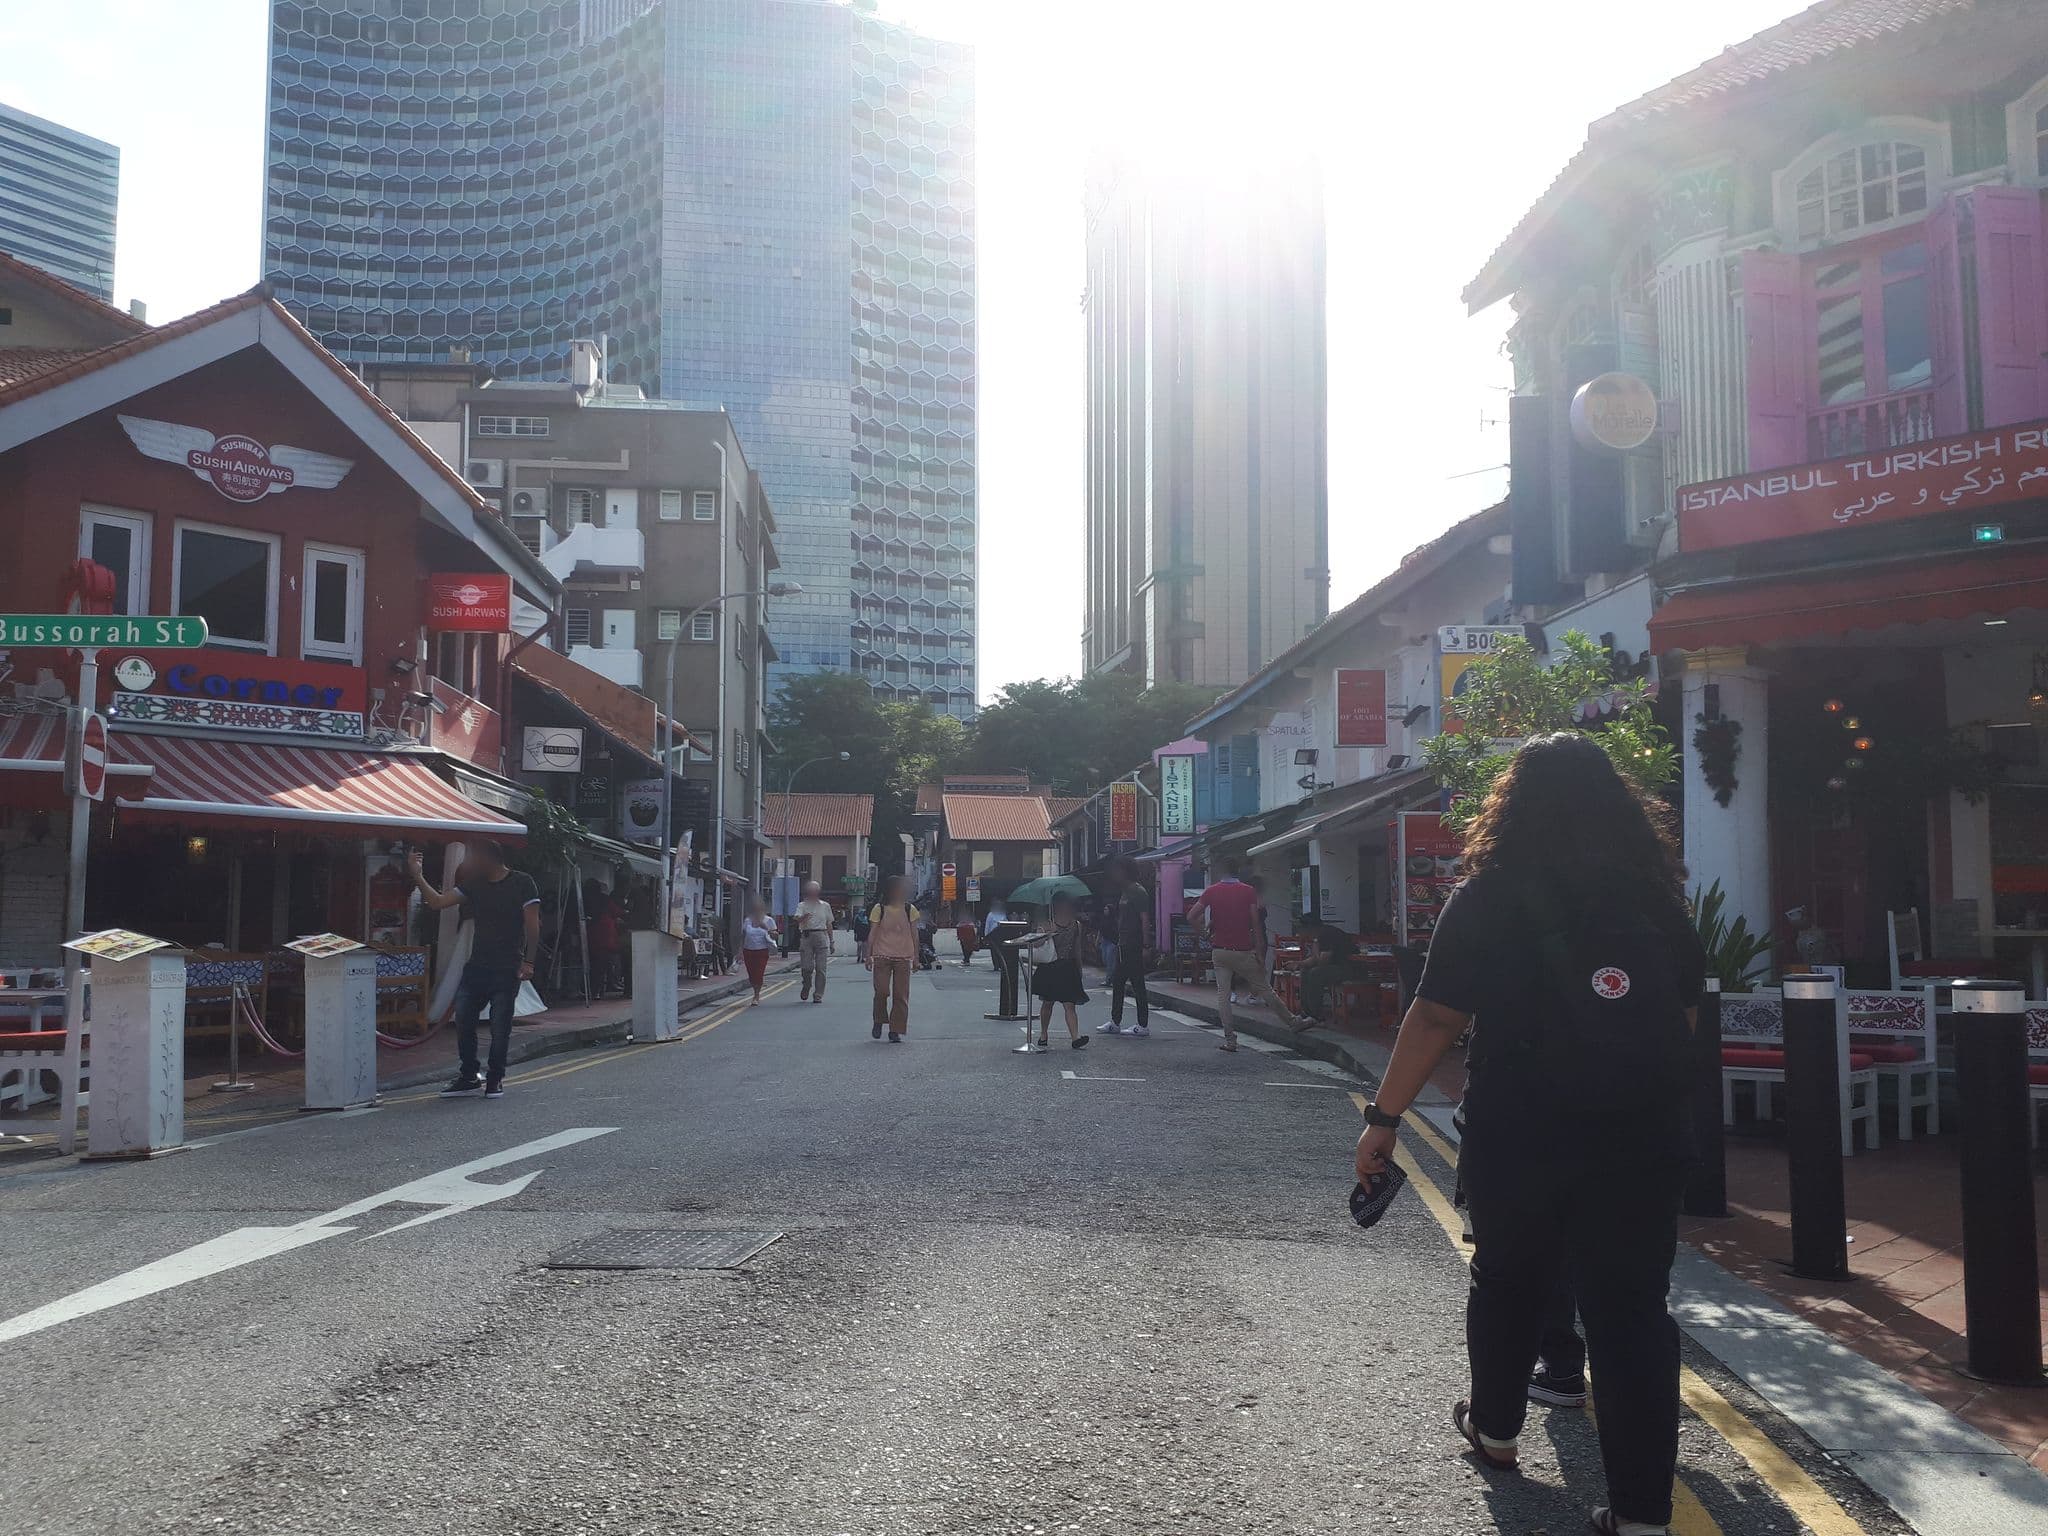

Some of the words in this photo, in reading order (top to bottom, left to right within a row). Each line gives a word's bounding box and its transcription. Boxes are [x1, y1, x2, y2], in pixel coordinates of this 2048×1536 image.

[220, 441, 264, 460] SUSHIBAR
[1683, 470, 1838, 511] ISTANBUL
[1845, 436, 2001, 481] TURKISH
[432, 607, 462, 617] SUSHI
[464, 607, 506, 619] AIRWAYS
[156, 620, 186, 643] St
[166, 663, 344, 708] Corner
[1165, 766, 1180, 831] ISTANBLUE
